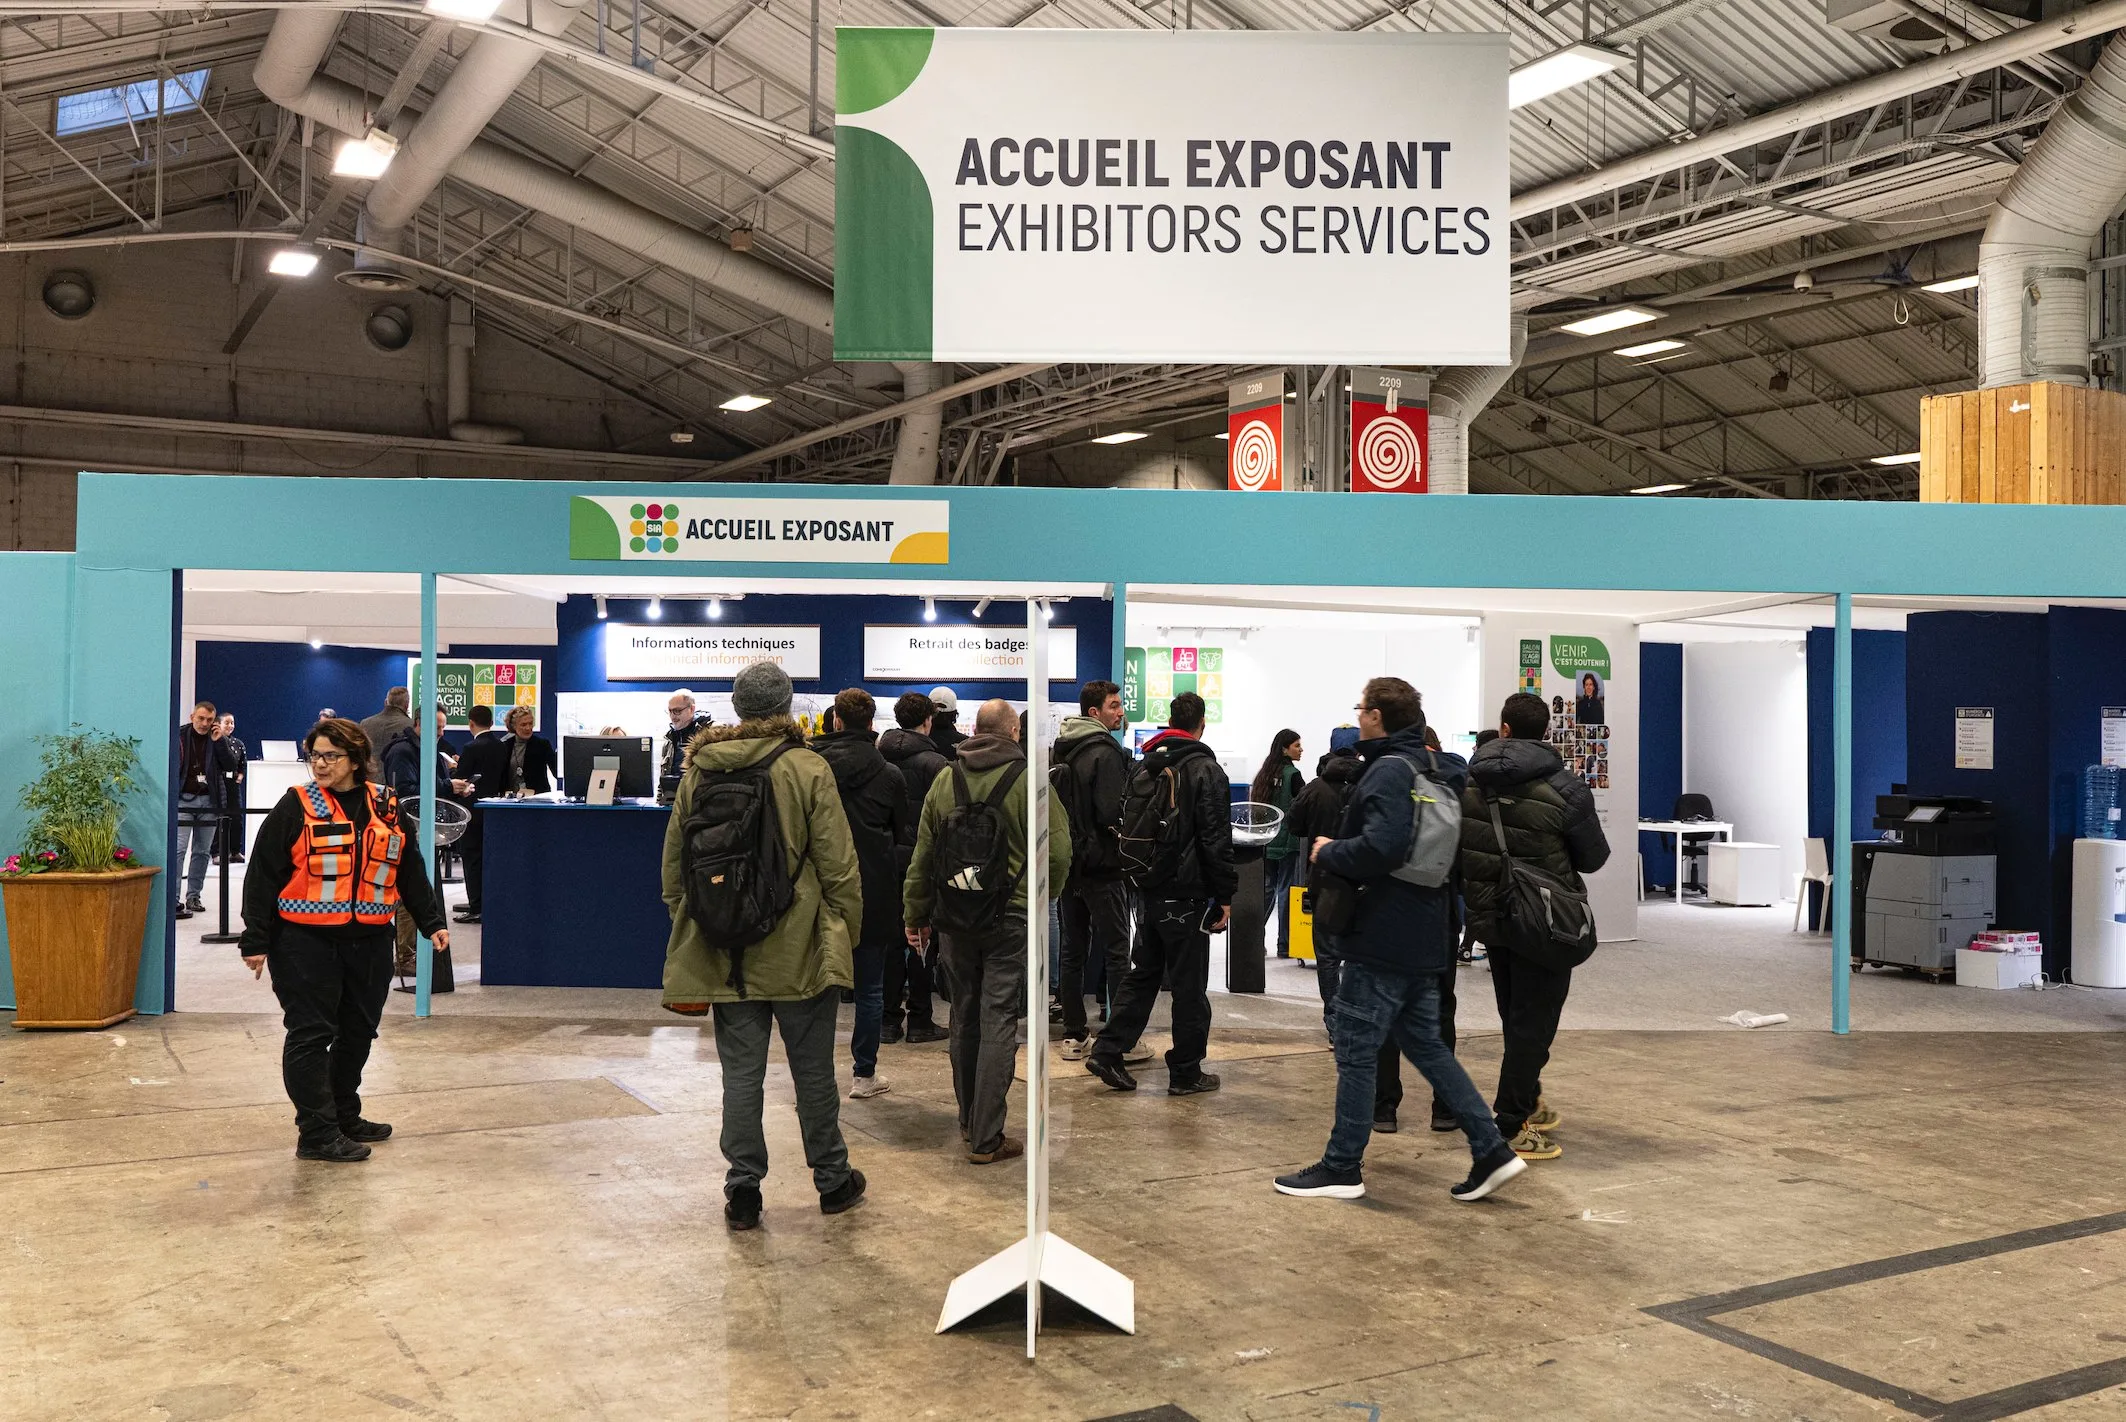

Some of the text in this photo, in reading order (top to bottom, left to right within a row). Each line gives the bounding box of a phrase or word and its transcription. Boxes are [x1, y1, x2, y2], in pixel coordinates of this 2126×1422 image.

[955, 137, 1451, 189] ACCUEIL EXPOSANT
[958, 203, 1491, 256] EXHIBITORS SERVICES
[1246, 382, 1263, 395] 2209
[1379, 376, 1402, 388] 2209
[685, 518, 894, 542] ACCUEIL EXPOSANT
[632, 636, 796, 652] Informations techniques
[909, 637, 953, 650] Retrait
[958, 638, 981, 650] des
[1555, 644, 1588, 658] VENIR
[1555, 658, 1573, 666] C'EST
